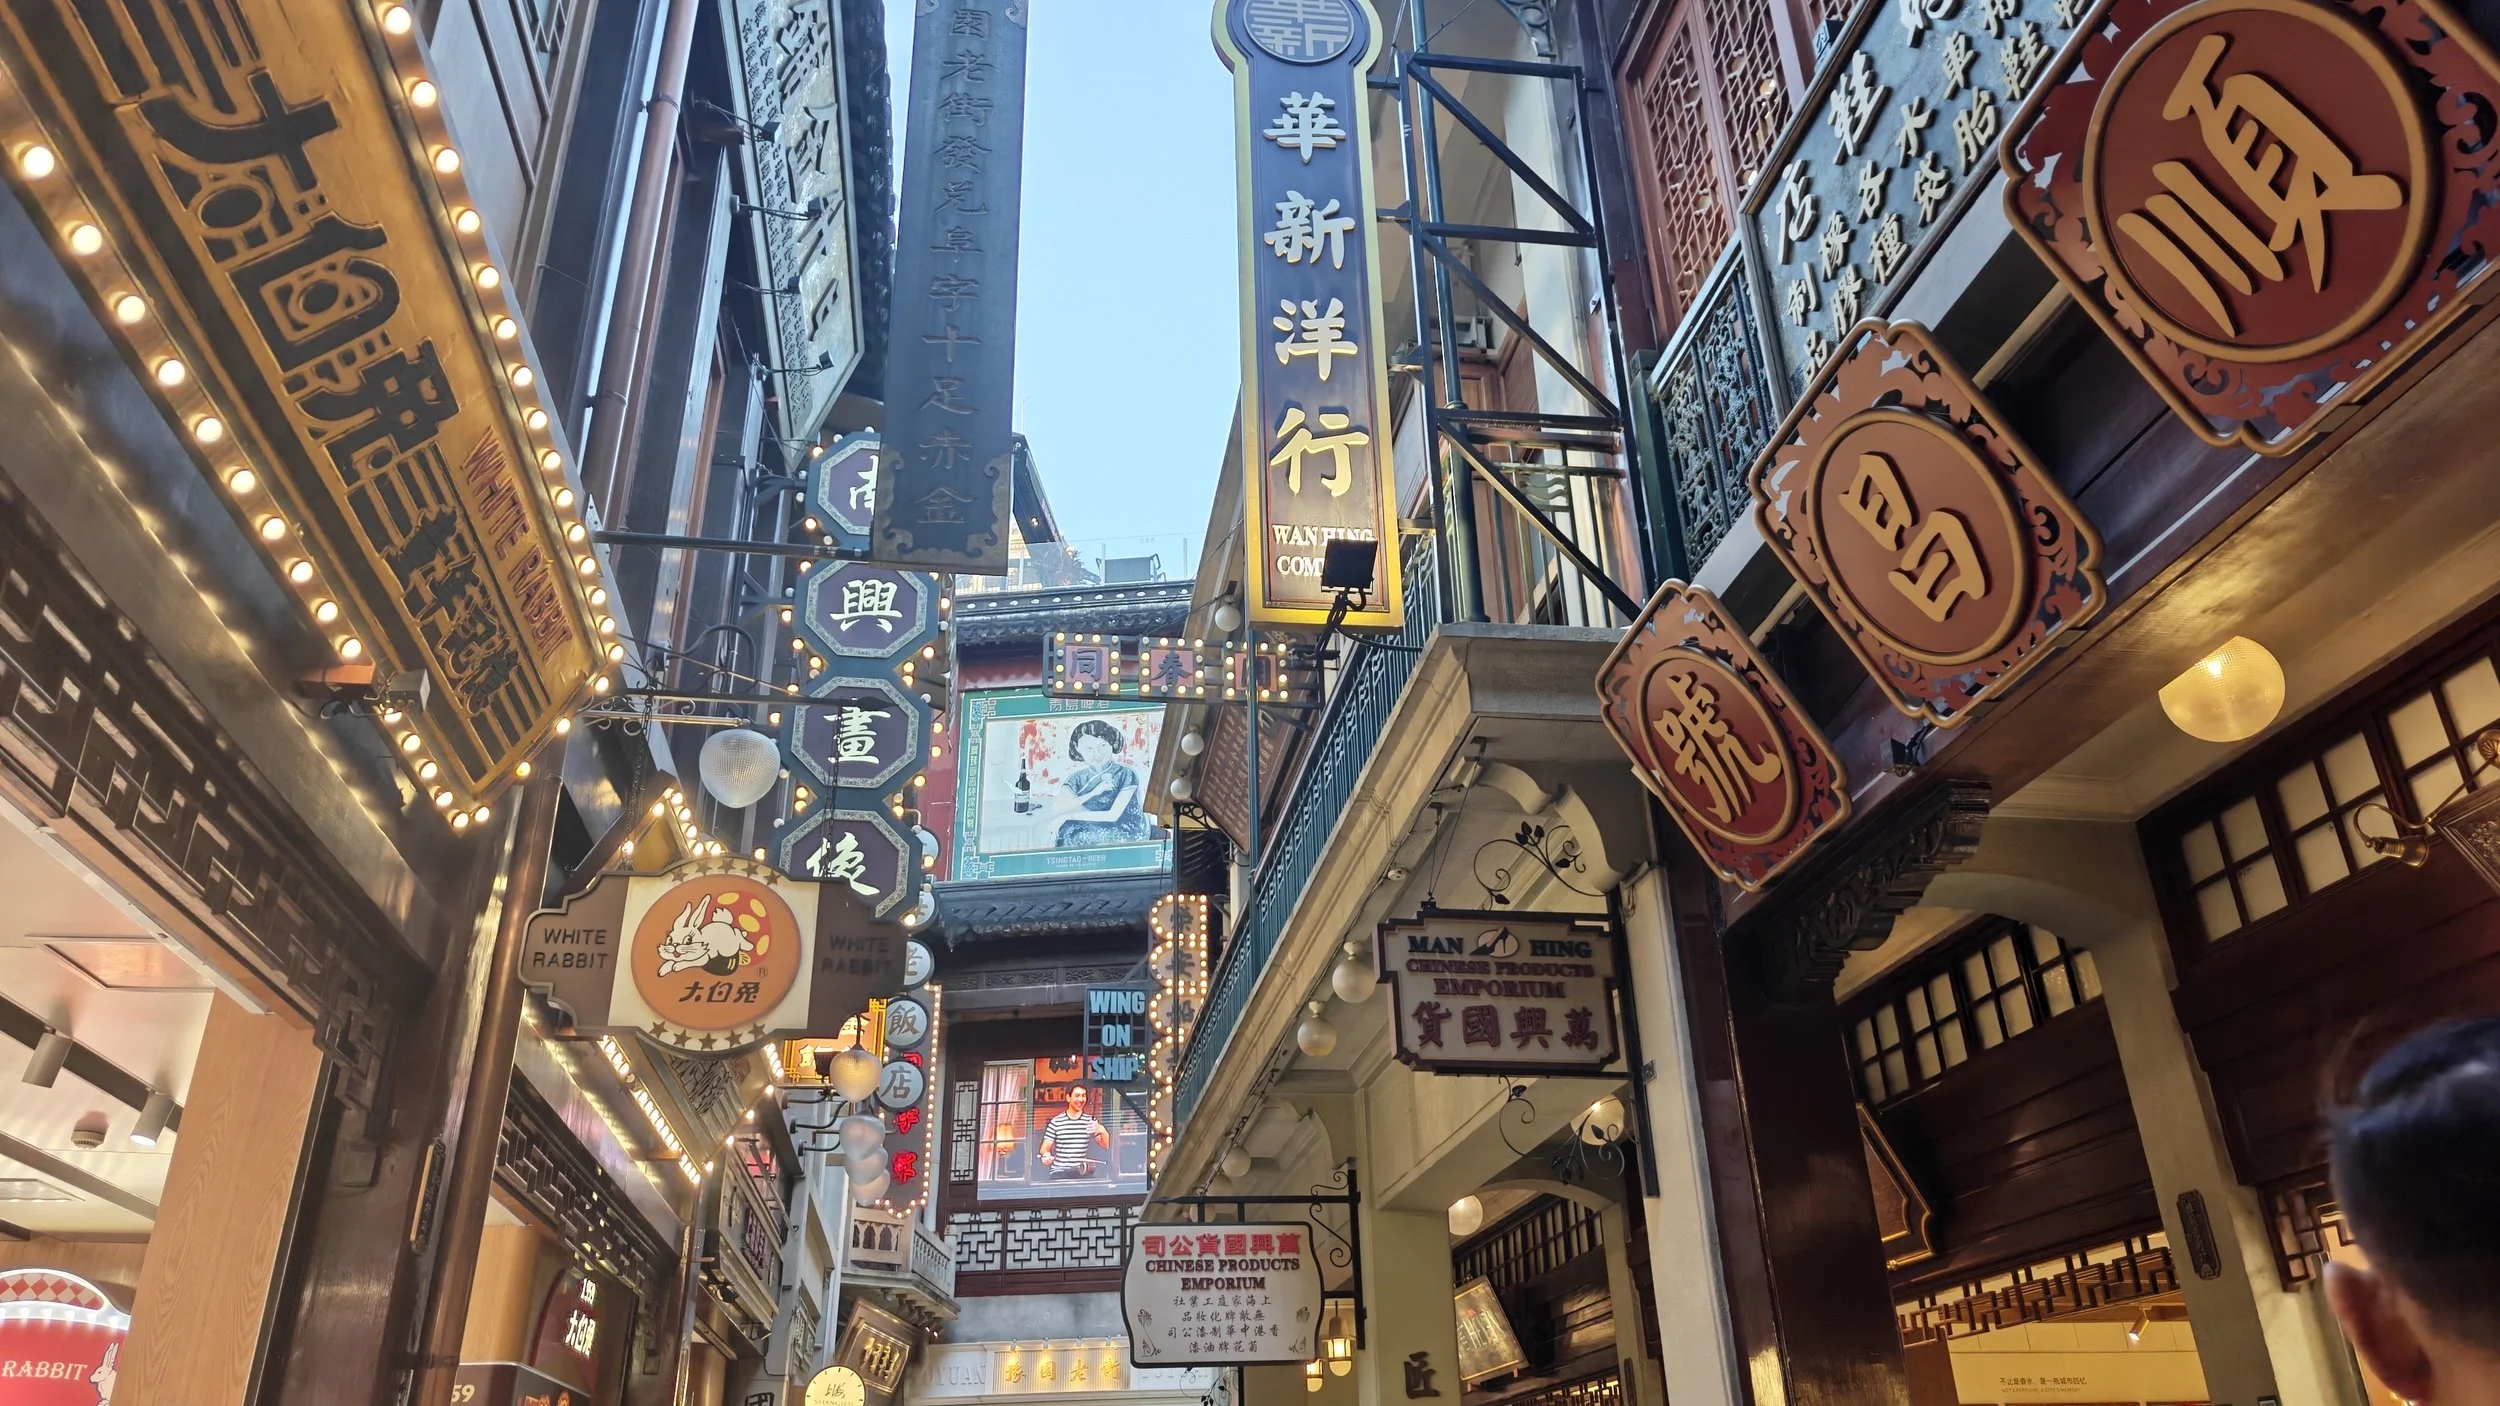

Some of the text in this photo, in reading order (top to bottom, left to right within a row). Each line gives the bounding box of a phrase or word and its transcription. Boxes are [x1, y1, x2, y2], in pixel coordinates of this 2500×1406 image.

[1263, 91, 1370, 498] 華新洋行
[461, 425, 572, 661] WHITE RABBIT
[1272, 524, 1318, 546] WAN
[544, 928, 607, 946] WHITE
[829, 935, 891, 954] WHITE
[1408, 936, 1592, 958] MAN HING
[533, 953, 609, 970] RABBIT
[821, 958, 894, 975] RABBIT
[1406, 959, 1595, 978] CHINESE PRODUCTS
[679, 981, 761, 1005] 大白兔
[1434, 978, 1567, 999] EMPORIUM
[1090, 991, 1146, 1014] WING
[1102, 1024, 1131, 1047] ON
[1091, 1057, 1138, 1081] SHIP
[1146, 1258, 1300, 1273] CHINESE PRODUCTS
[1181, 1277, 1266, 1291] EMPORIUM
[2, 1361, 88, 1381] RABBIT
[1404, 1351, 1440, 1399] 匠
